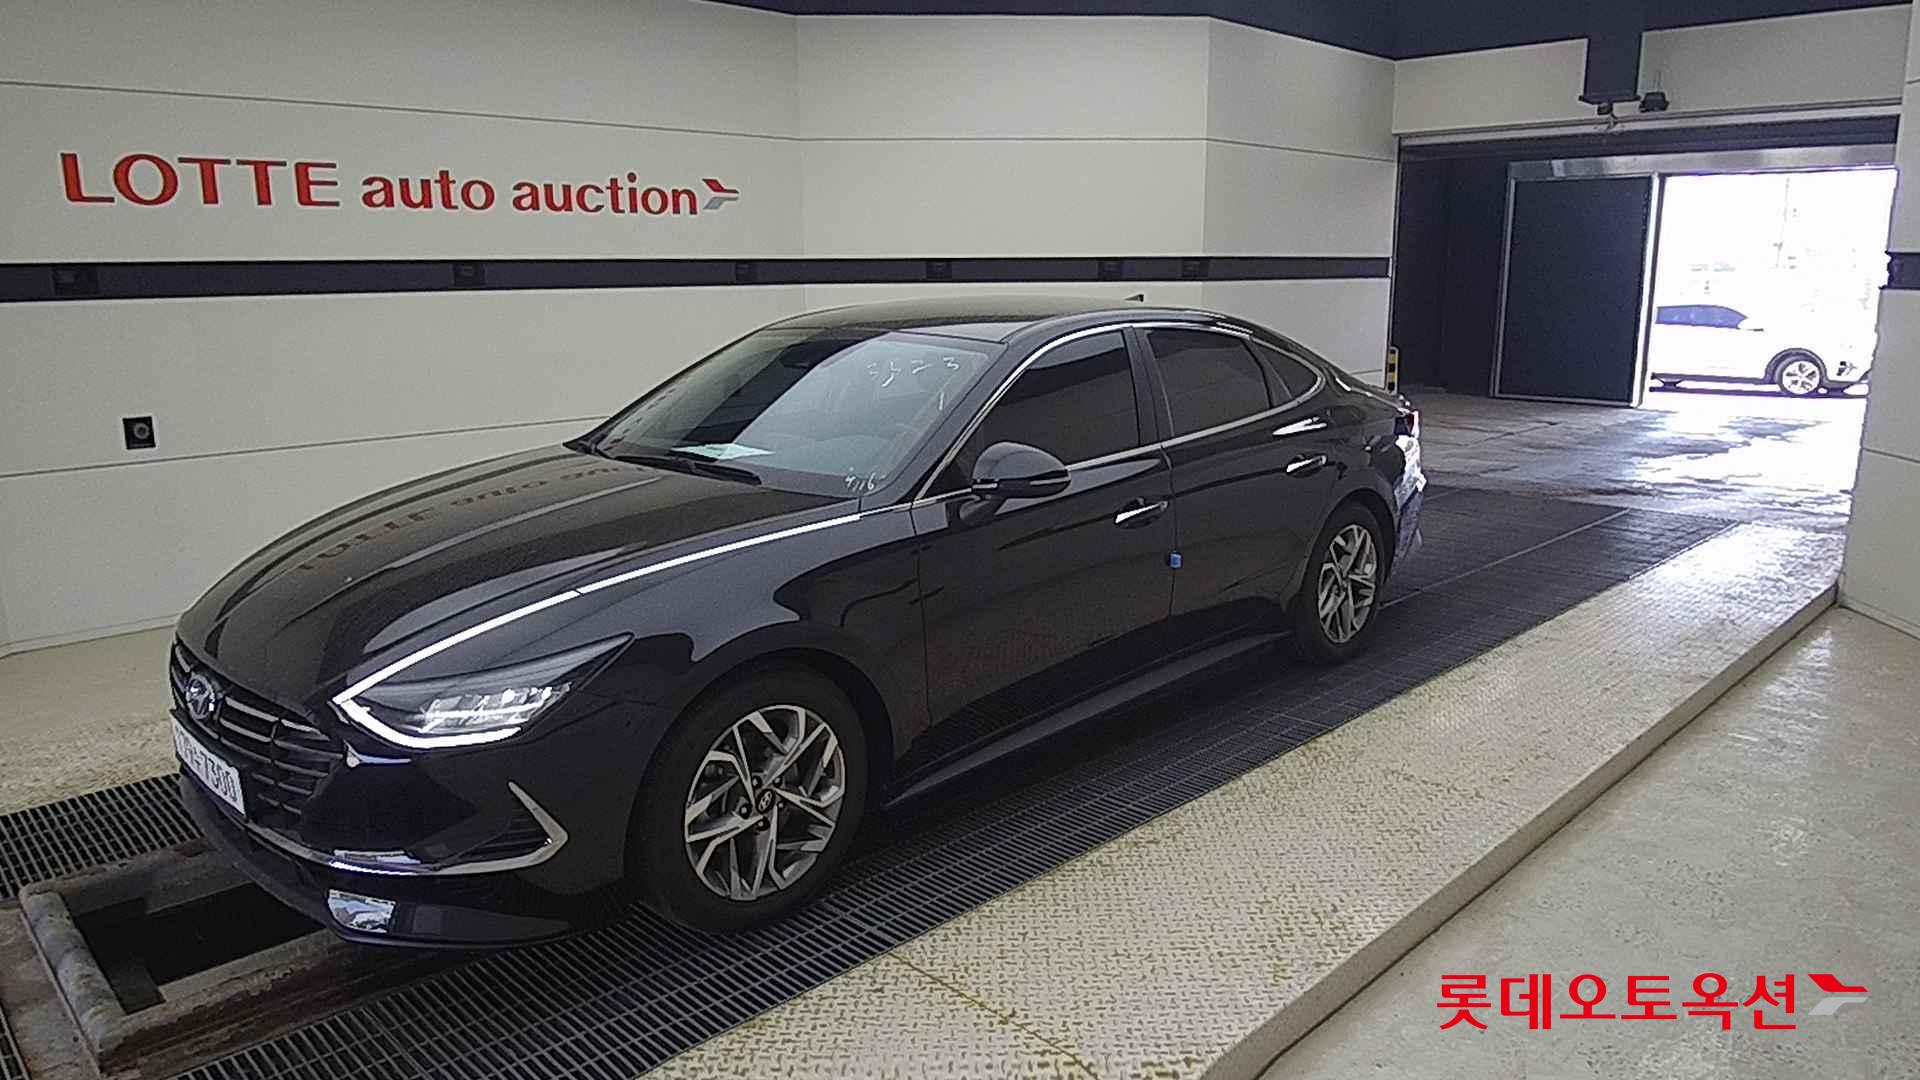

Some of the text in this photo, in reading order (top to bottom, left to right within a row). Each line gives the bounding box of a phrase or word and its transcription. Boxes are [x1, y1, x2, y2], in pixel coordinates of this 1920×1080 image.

[61, 153, 699, 215] LOTTE auto auction
